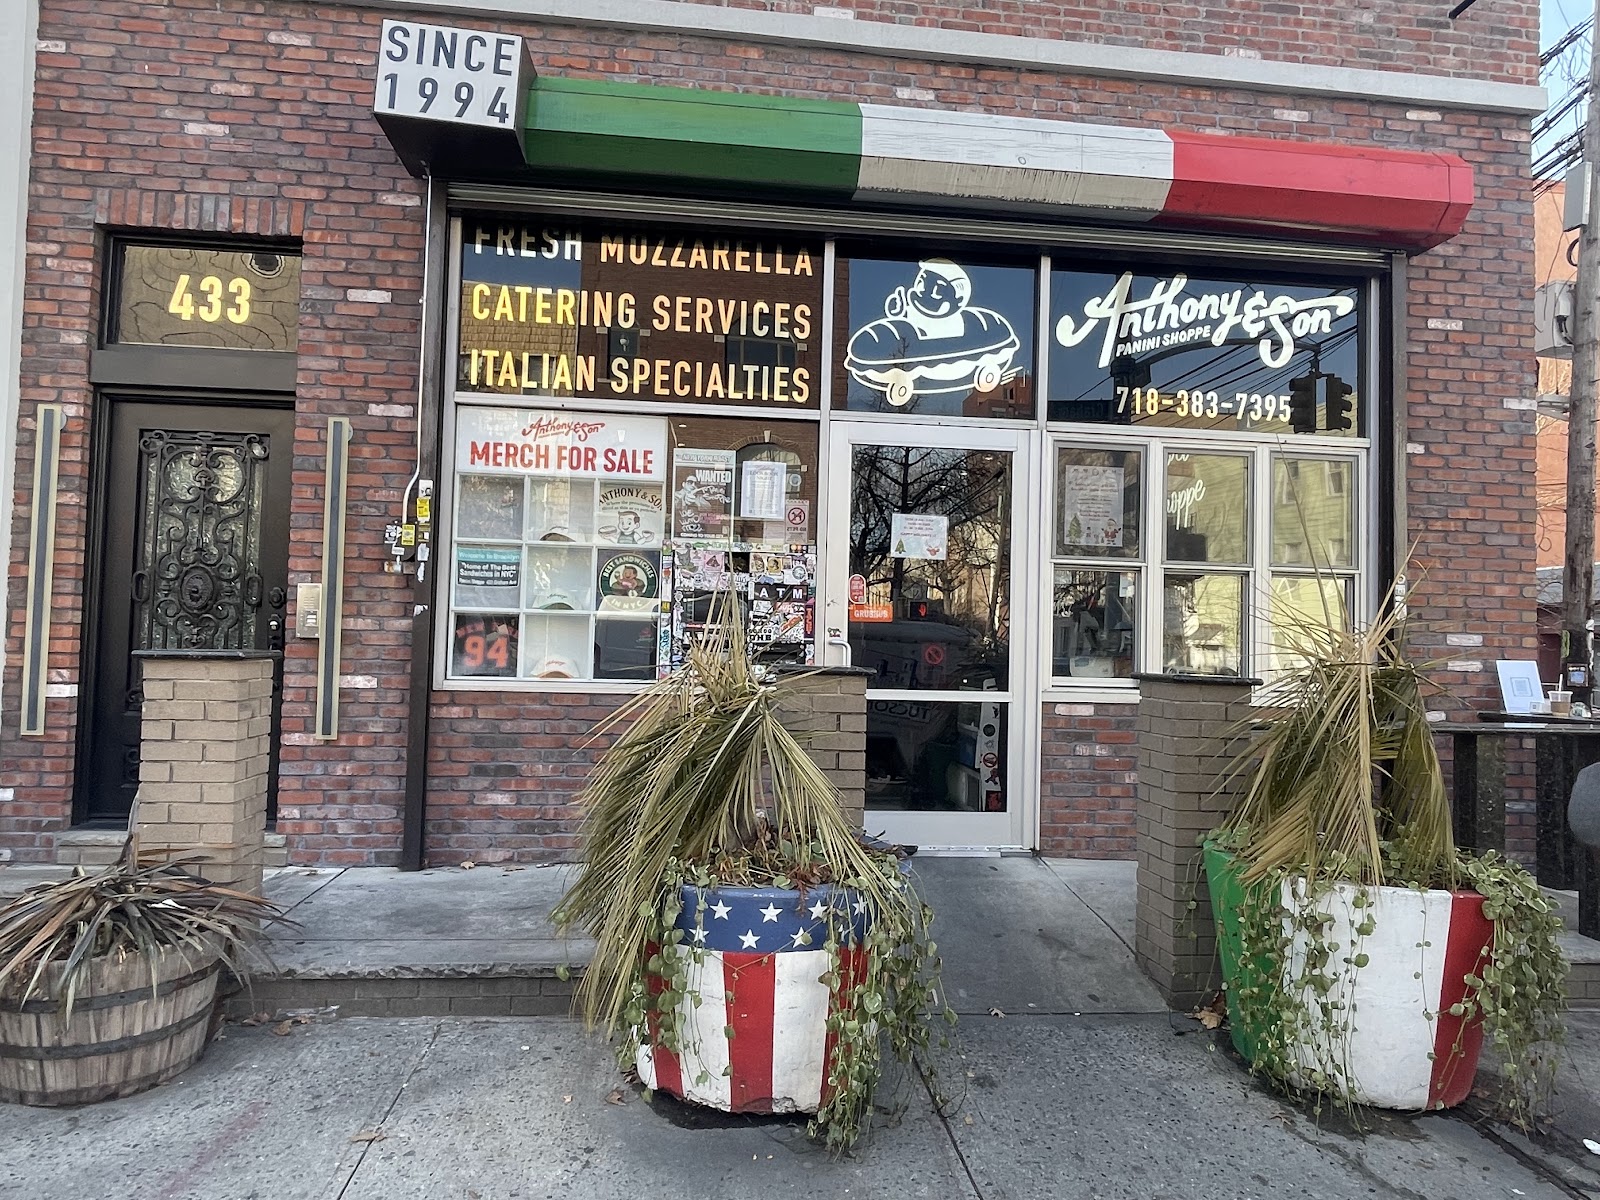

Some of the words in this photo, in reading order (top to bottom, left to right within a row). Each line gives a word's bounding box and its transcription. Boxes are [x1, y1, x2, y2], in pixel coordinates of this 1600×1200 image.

[386, 25, 516, 77] SINCE
[384, 72, 509, 124] 1994
[474, 224, 582, 261] FRESH
[169, 274, 251, 324] 433
[472, 283, 635, 329] CATERING
[652, 294, 811, 340] SERVICES
[1116, 336, 1161, 358] PANINI
[1162, 325, 1211, 348] SHOPPE
[470, 349, 595, 392] ITALIAN
[610, 356, 810, 403] SPECIALTIES
[1116, 386, 1292, 423] 718-383-7395
[470, 441, 549, 470] MERCH
[557, 445, 598, 472] FOR
[603, 448, 653, 474] SALE
[695, 469, 731, 483] WANTED
[459, 551, 485, 559] Welcome
[603, 561, 616, 578] BEST
[615, 556, 654, 578] SANDWICHES
[460, 569, 493, 577] Sandwiches
[611, 598, 621, 606] IN
[622, 600, 643, 609] NYC
[760, 587, 803, 599] ATM
[464, 635, 508, 668] 94
